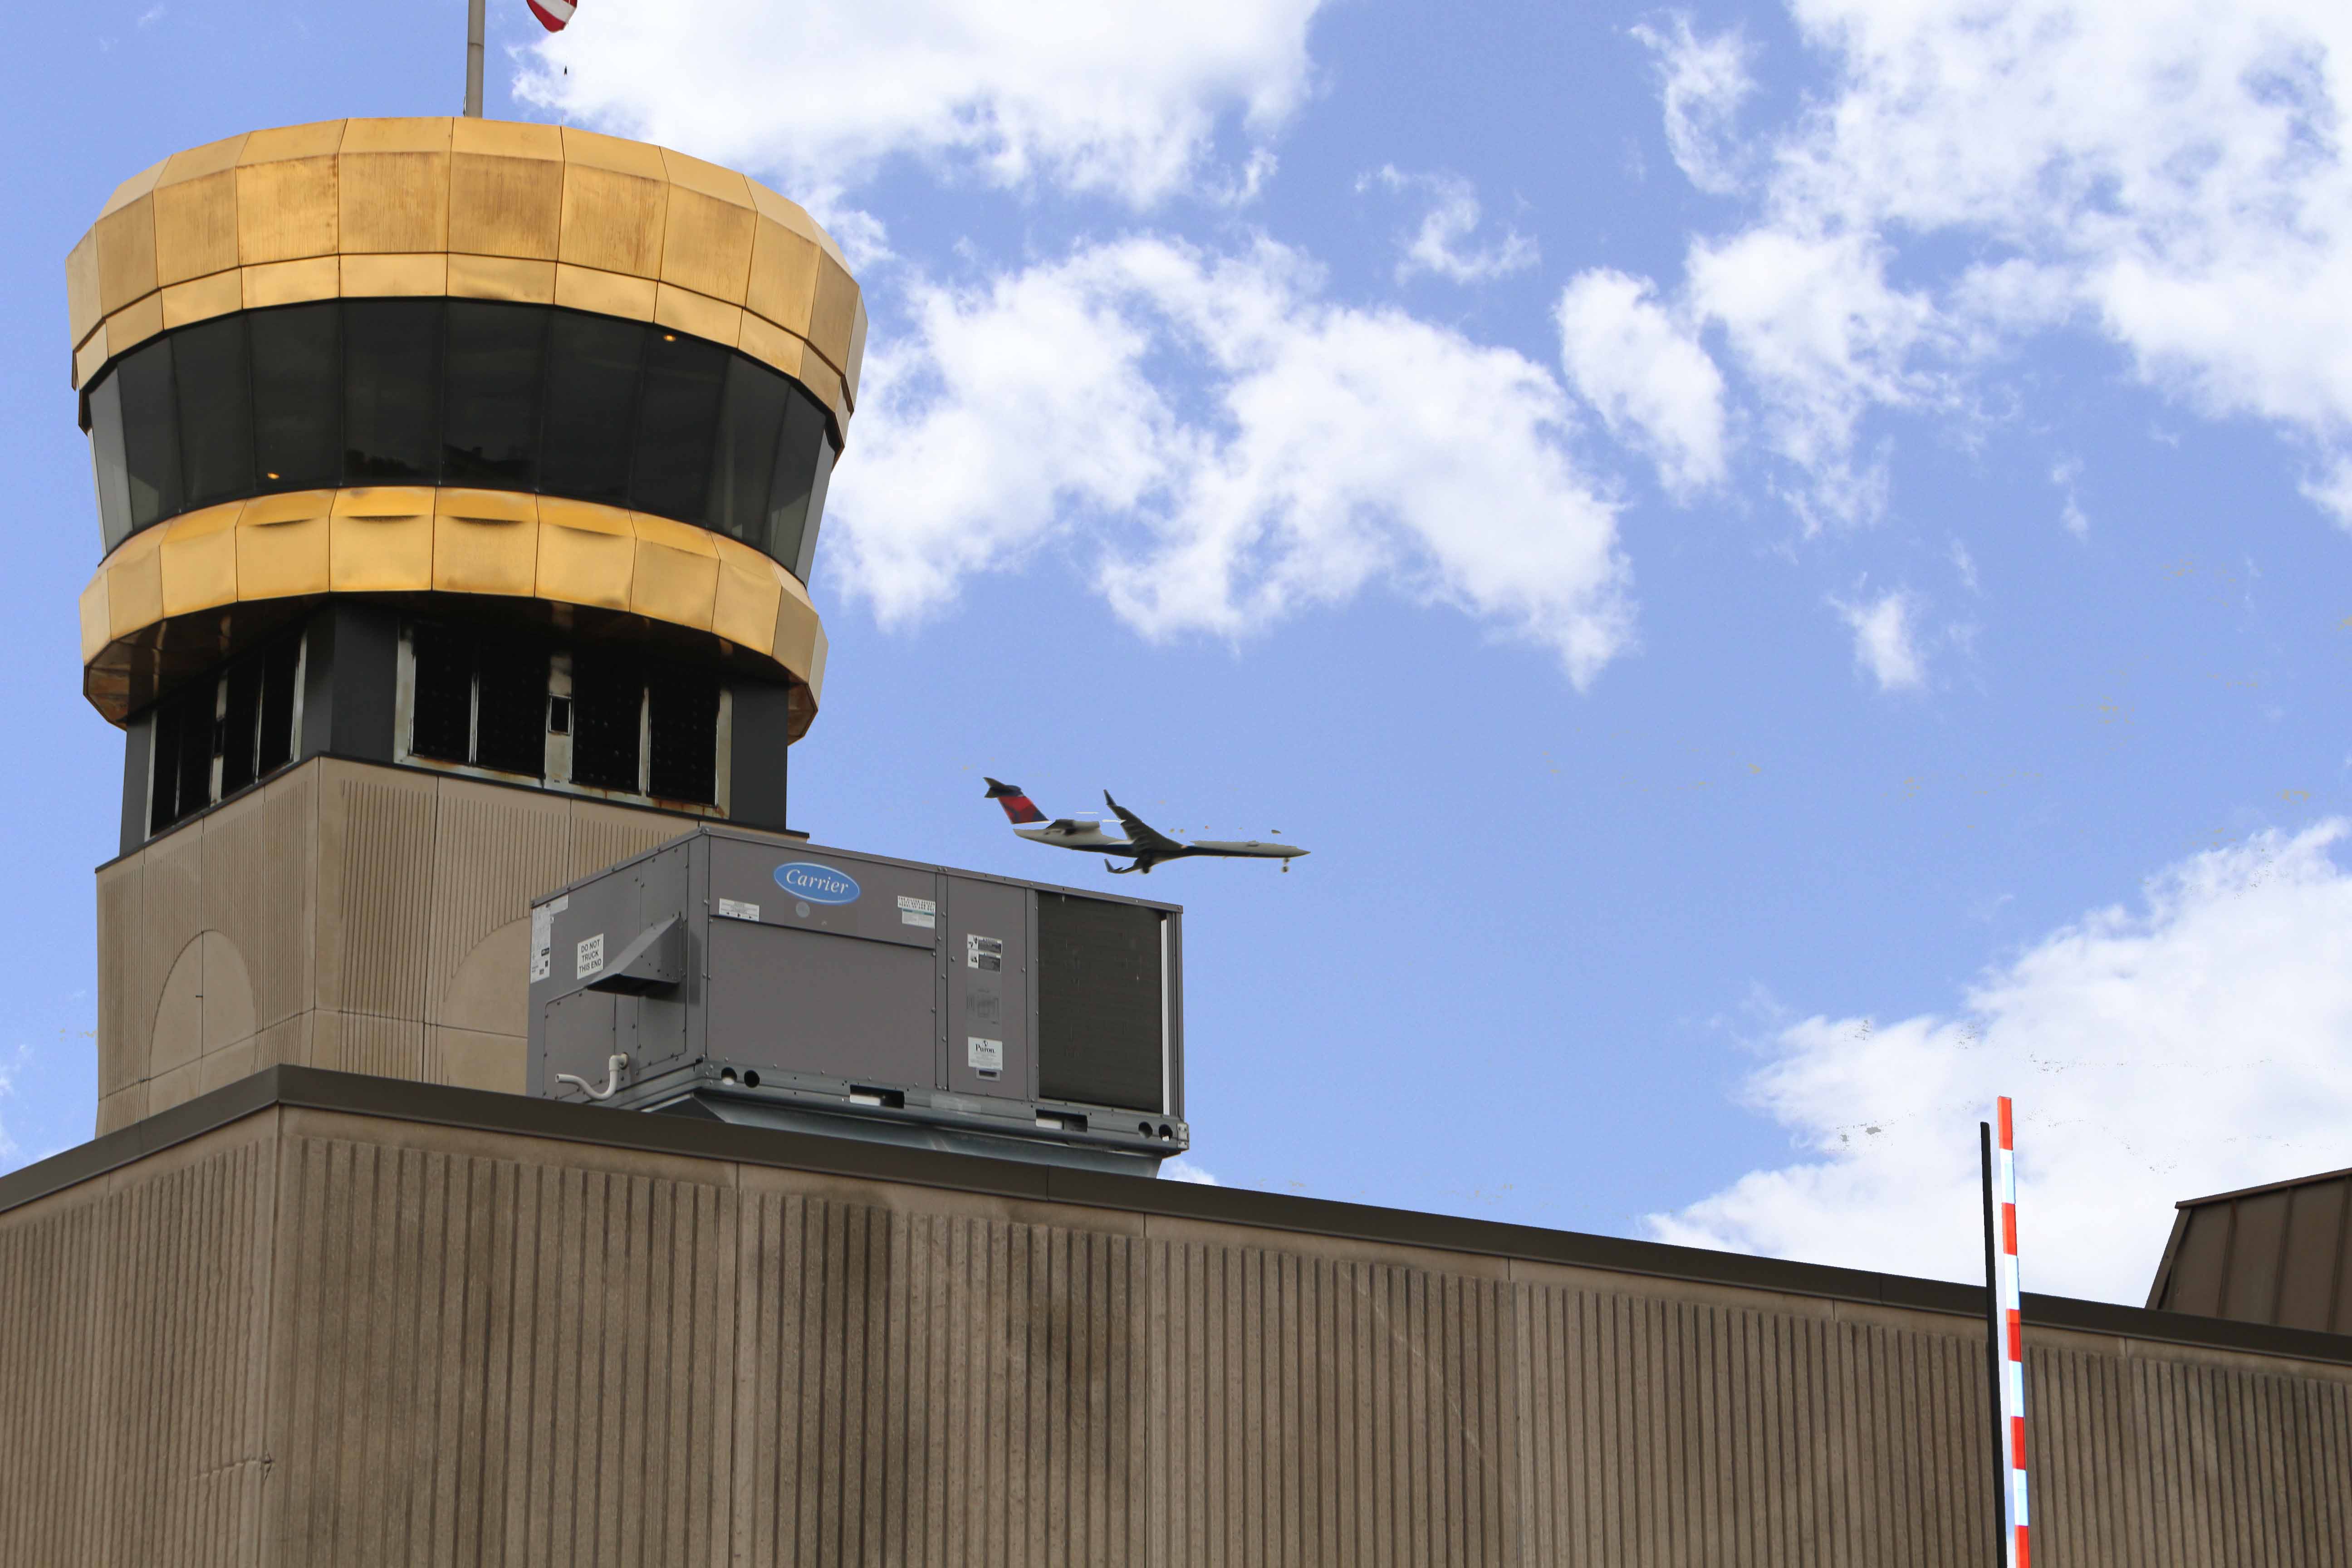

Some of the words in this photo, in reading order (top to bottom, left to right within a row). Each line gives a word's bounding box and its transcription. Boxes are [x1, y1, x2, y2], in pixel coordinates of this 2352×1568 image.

[786, 869, 848, 893] Carrier
[581, 944, 588, 952] DO
[590, 940, 599, 950] NOT
[582, 951, 599, 962] TRUCK
[579, 963, 590, 973] THIS
[591, 958, 602, 969] END
[976, 1044, 995, 1053] Puron
